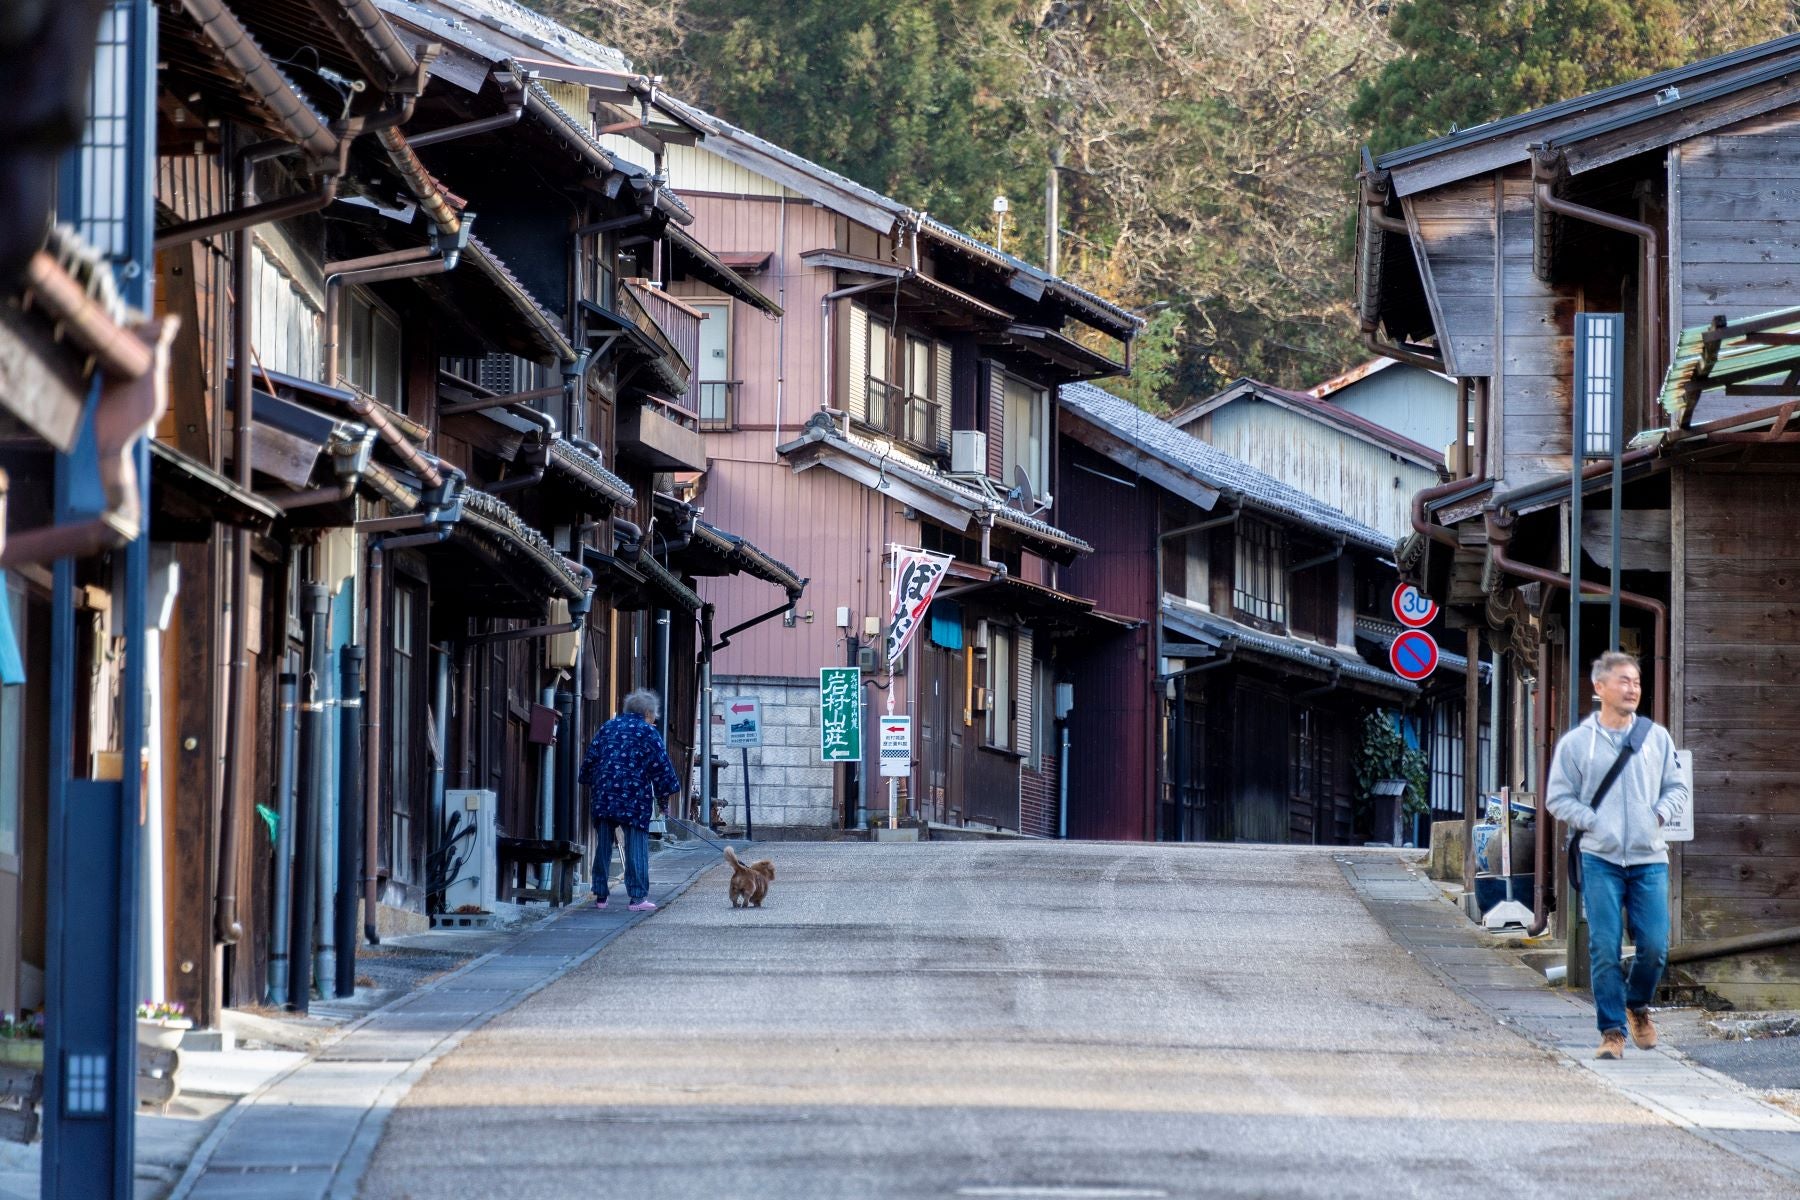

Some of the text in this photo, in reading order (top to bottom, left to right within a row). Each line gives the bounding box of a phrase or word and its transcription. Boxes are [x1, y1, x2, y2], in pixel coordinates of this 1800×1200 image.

[1403, 591, 1429, 613] 30
[822, 670, 851, 749] 岩村山荘
